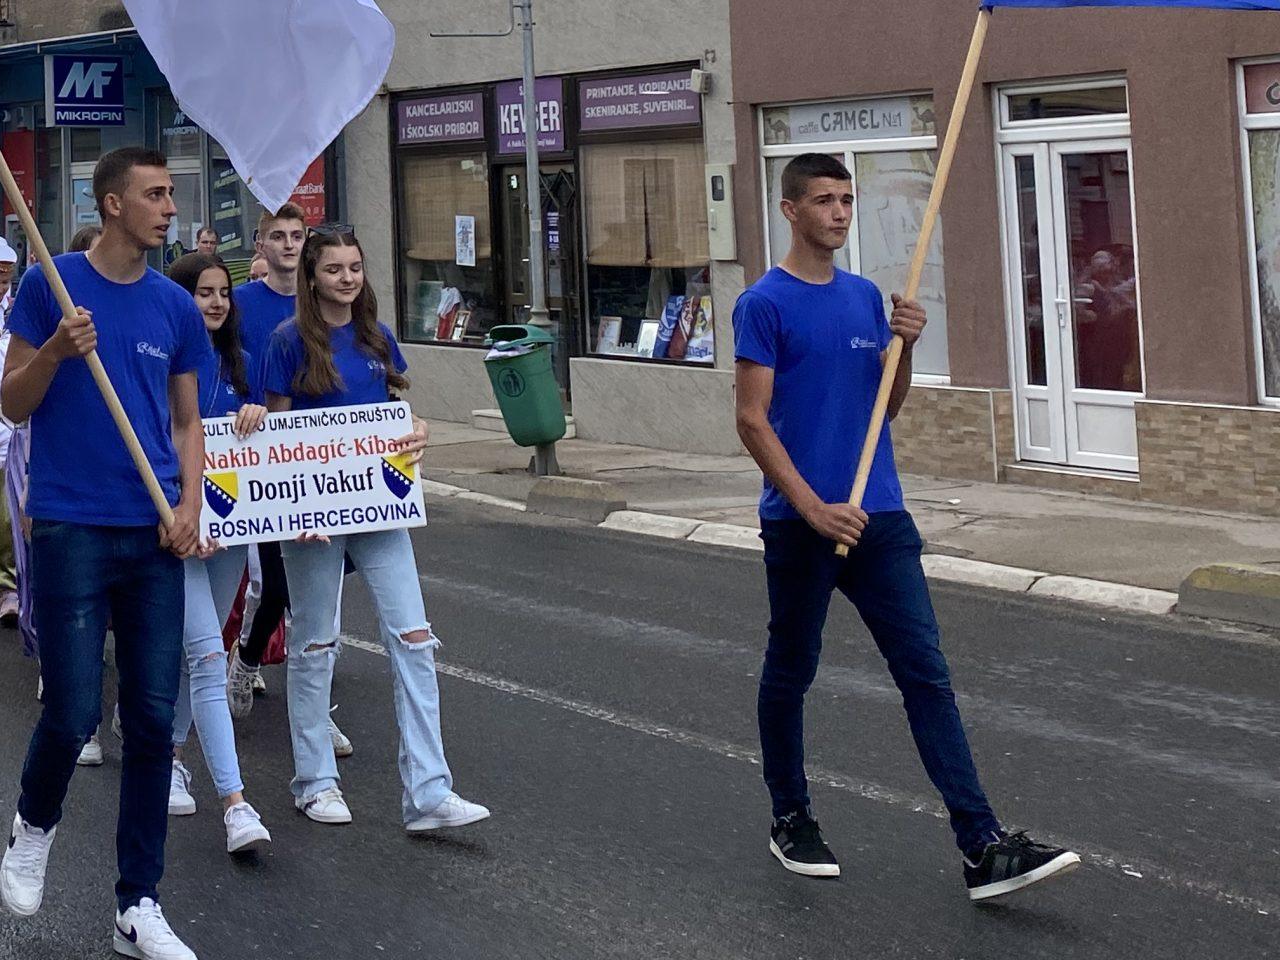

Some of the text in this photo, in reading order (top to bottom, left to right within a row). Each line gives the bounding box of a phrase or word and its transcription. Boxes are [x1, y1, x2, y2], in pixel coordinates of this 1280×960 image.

[58, 62, 118, 98] MF
[586, 84, 637, 99] PRINTANJE,
[56, 111, 122, 121] MIKROFIN
[406, 100, 474, 118] KANCELARIJSKI
[585, 103, 642, 118] SKENIRANJE,
[402, 121, 479, 139] I ŠKOLSKI PRIBOR
[798, 121, 819, 135] caffe
[821, 109, 880, 133] CAMEL
[203, 406, 406, 437] KULTUO UMJETNIČKO DRUŠTVO
[205, 446, 260, 470] Nakib
[248, 466, 374, 504] Donji Vakuf
[209, 502, 421, 539] BOSNA I HERCEGOVINA
